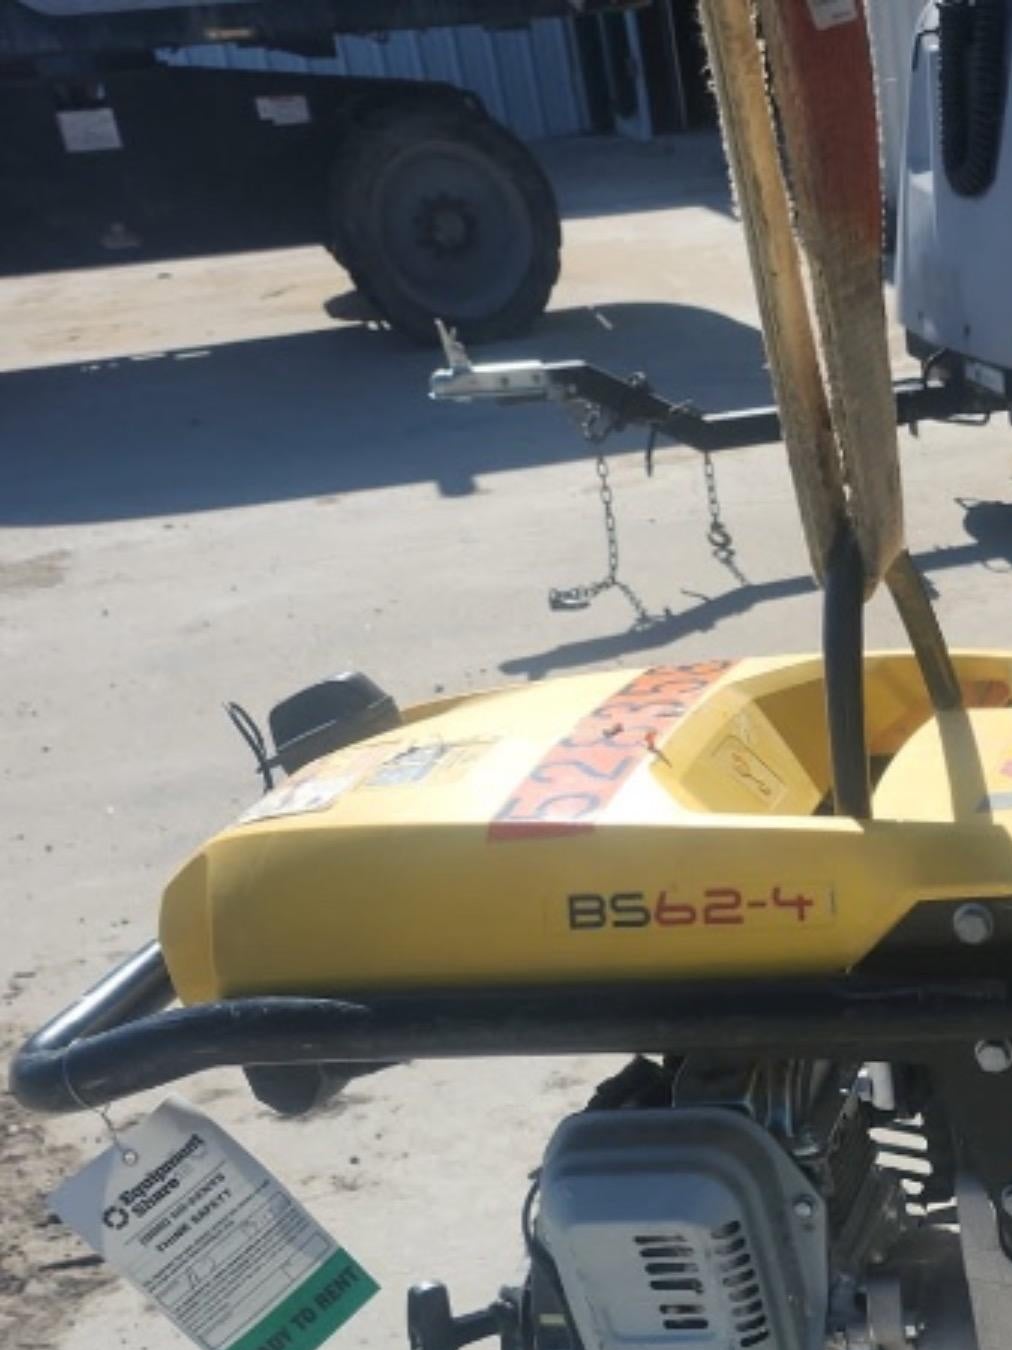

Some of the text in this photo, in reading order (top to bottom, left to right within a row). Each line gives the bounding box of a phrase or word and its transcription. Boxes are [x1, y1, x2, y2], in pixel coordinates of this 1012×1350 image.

[567, 886, 813, 930] BS62-4
[119, 1133, 204, 1206] Equipment
[131, 1178, 180, 1217] Share
[289, 1307, 317, 1331] TO
[313, 1263, 358, 1312] RENT
